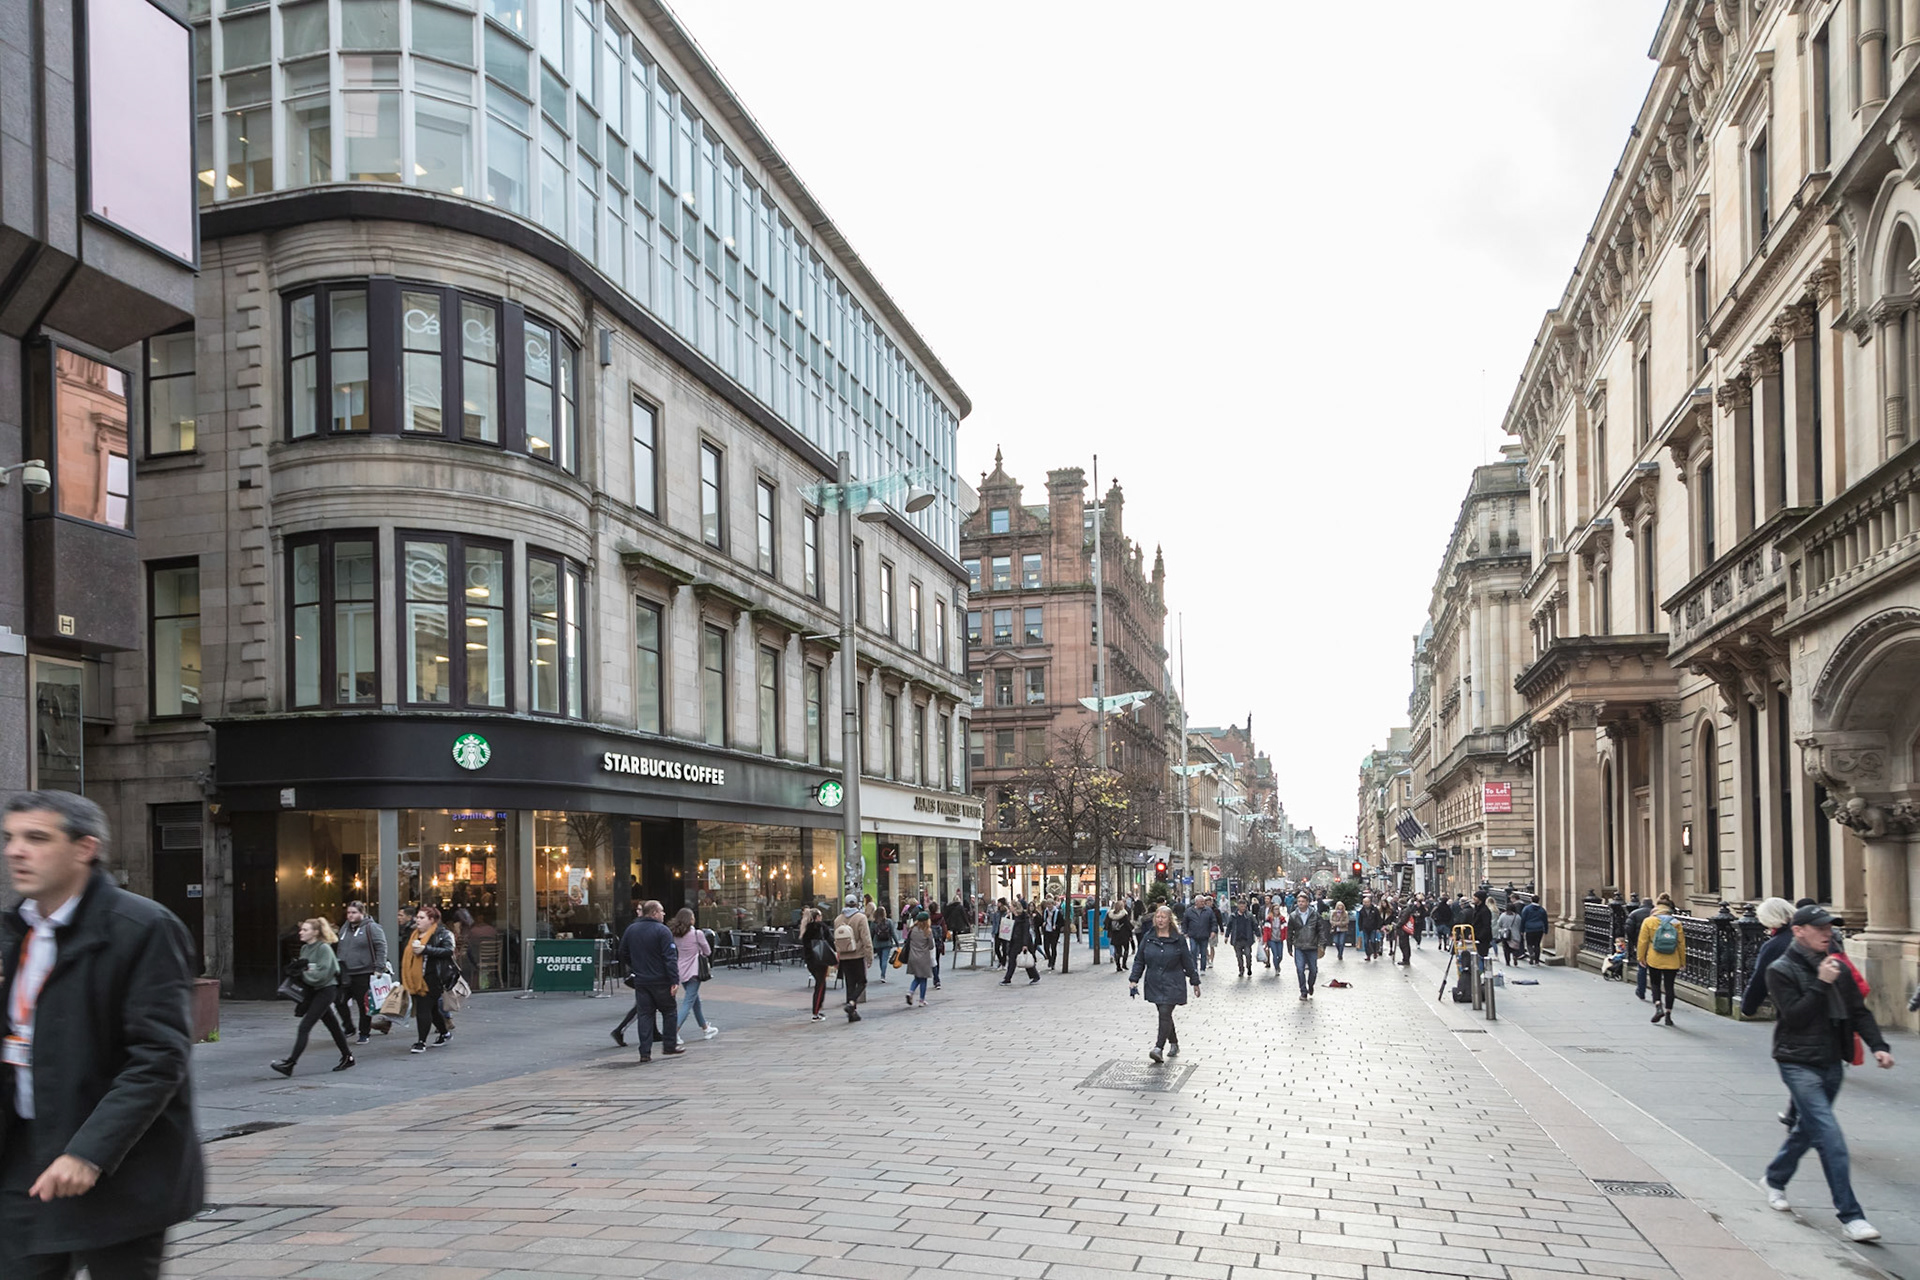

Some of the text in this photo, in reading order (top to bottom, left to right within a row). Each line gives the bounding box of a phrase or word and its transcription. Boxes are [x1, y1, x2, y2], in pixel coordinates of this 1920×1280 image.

[61, 617, 73, 634] H
[604, 752, 725, 785] STARBUCKS COFFEE
[536, 956, 593, 964] STARBUCKS
[546, 964, 583, 972] COFFEE
